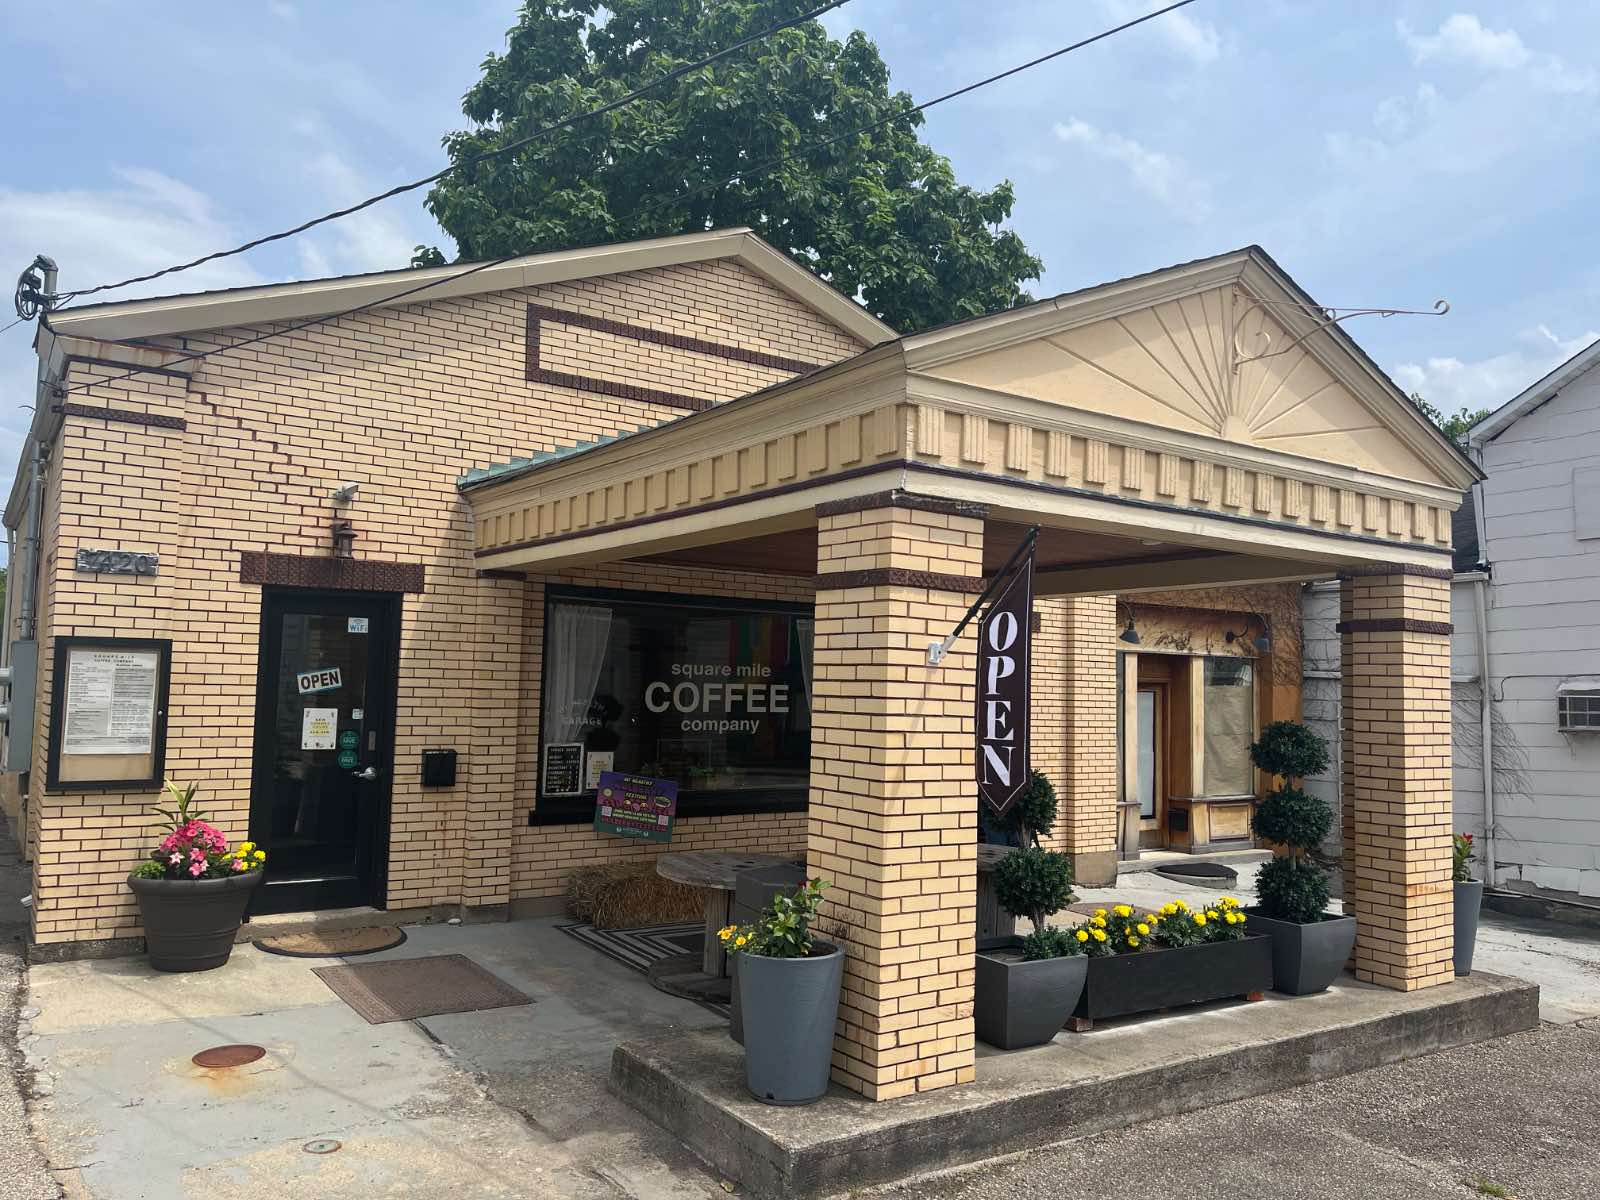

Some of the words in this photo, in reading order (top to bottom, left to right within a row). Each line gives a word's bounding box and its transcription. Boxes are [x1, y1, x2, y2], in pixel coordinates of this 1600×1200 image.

[671, 663, 731, 678] square
[736, 664, 772, 677] mile
[300, 671, 340, 690] OPEN
[645, 681, 789, 713] COFFEE
[981, 611, 1018, 786] OPEN
[681, 718, 760, 734] company
